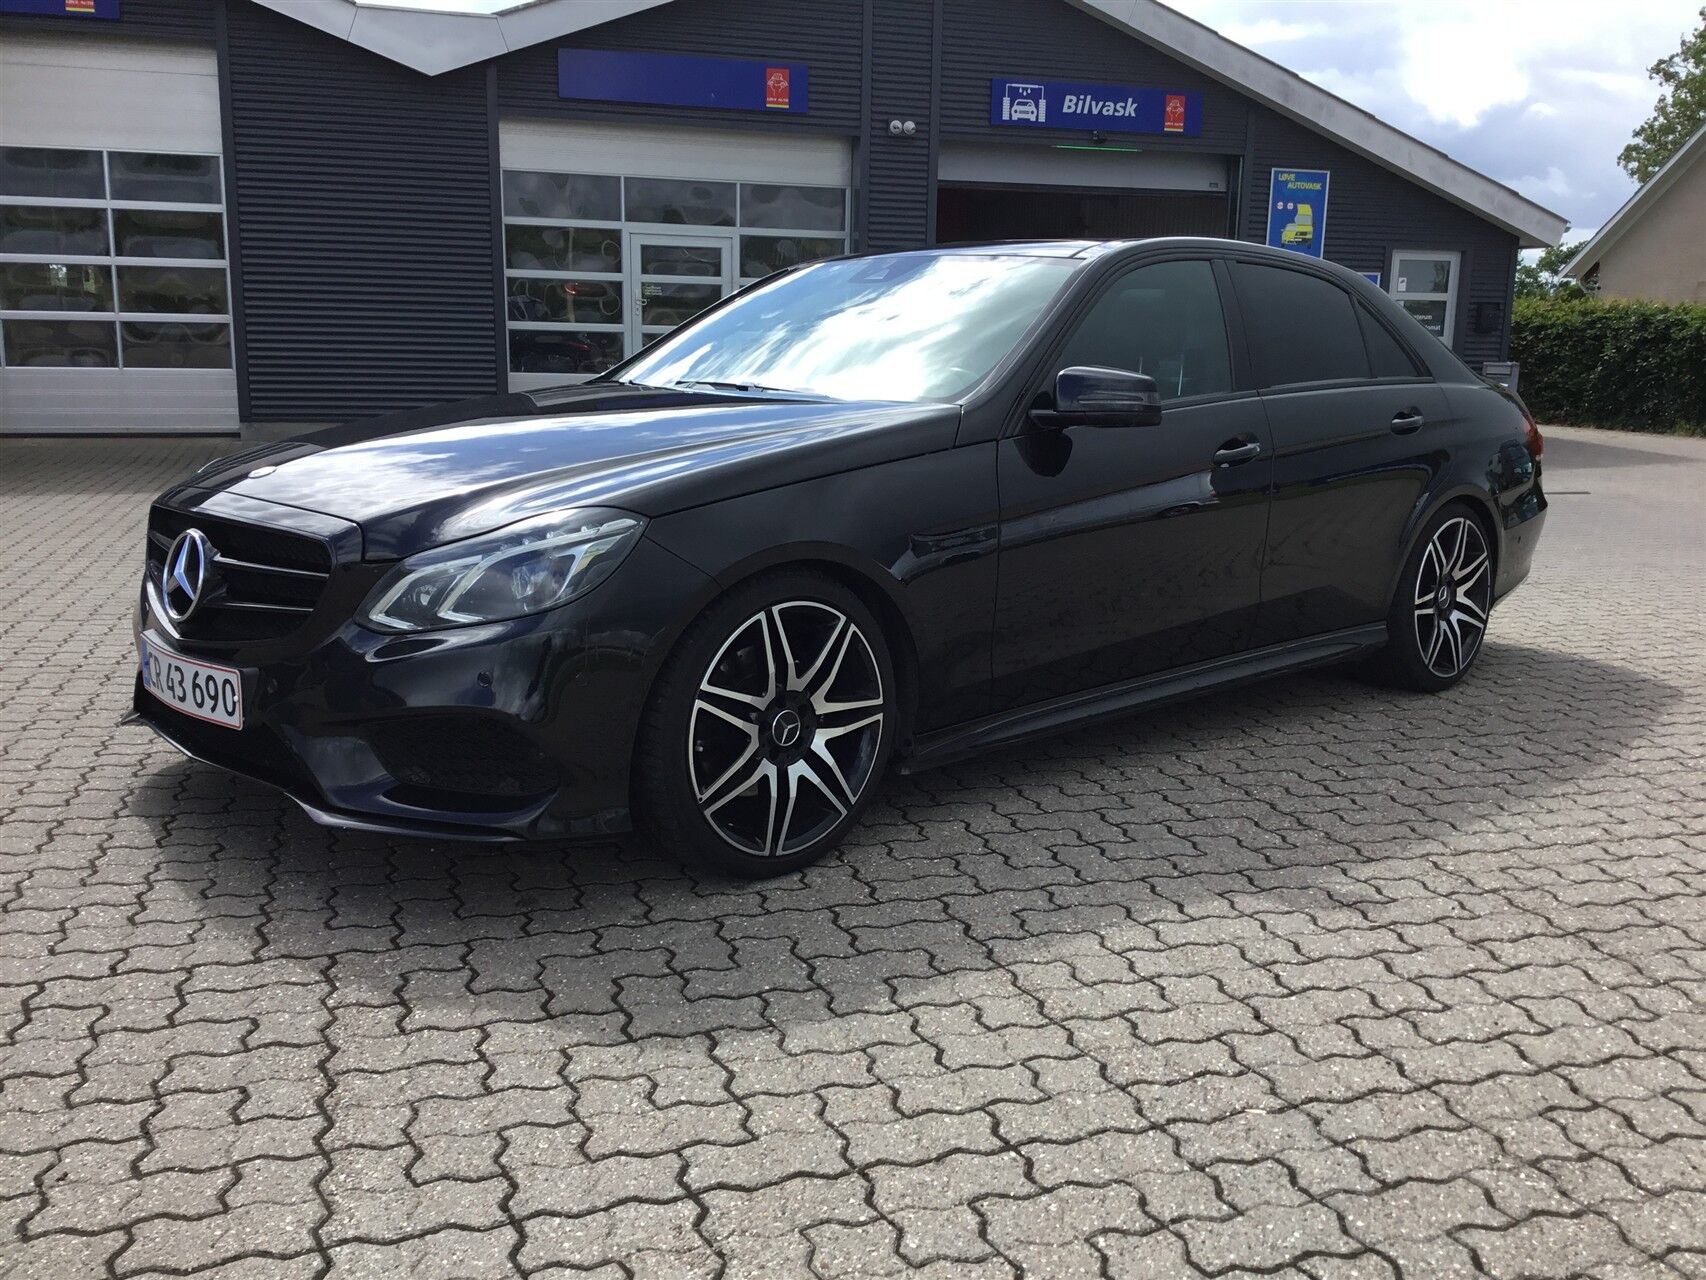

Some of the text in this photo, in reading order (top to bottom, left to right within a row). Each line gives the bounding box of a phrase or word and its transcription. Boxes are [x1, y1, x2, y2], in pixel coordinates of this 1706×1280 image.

[1062, 95, 1138, 117] Bilvask
[1278, 173, 1296, 181] LØVE
[1287, 181, 1322, 190] AUTOVASK
[166, 663, 187, 703] 43
[191, 670, 237, 717] 690
